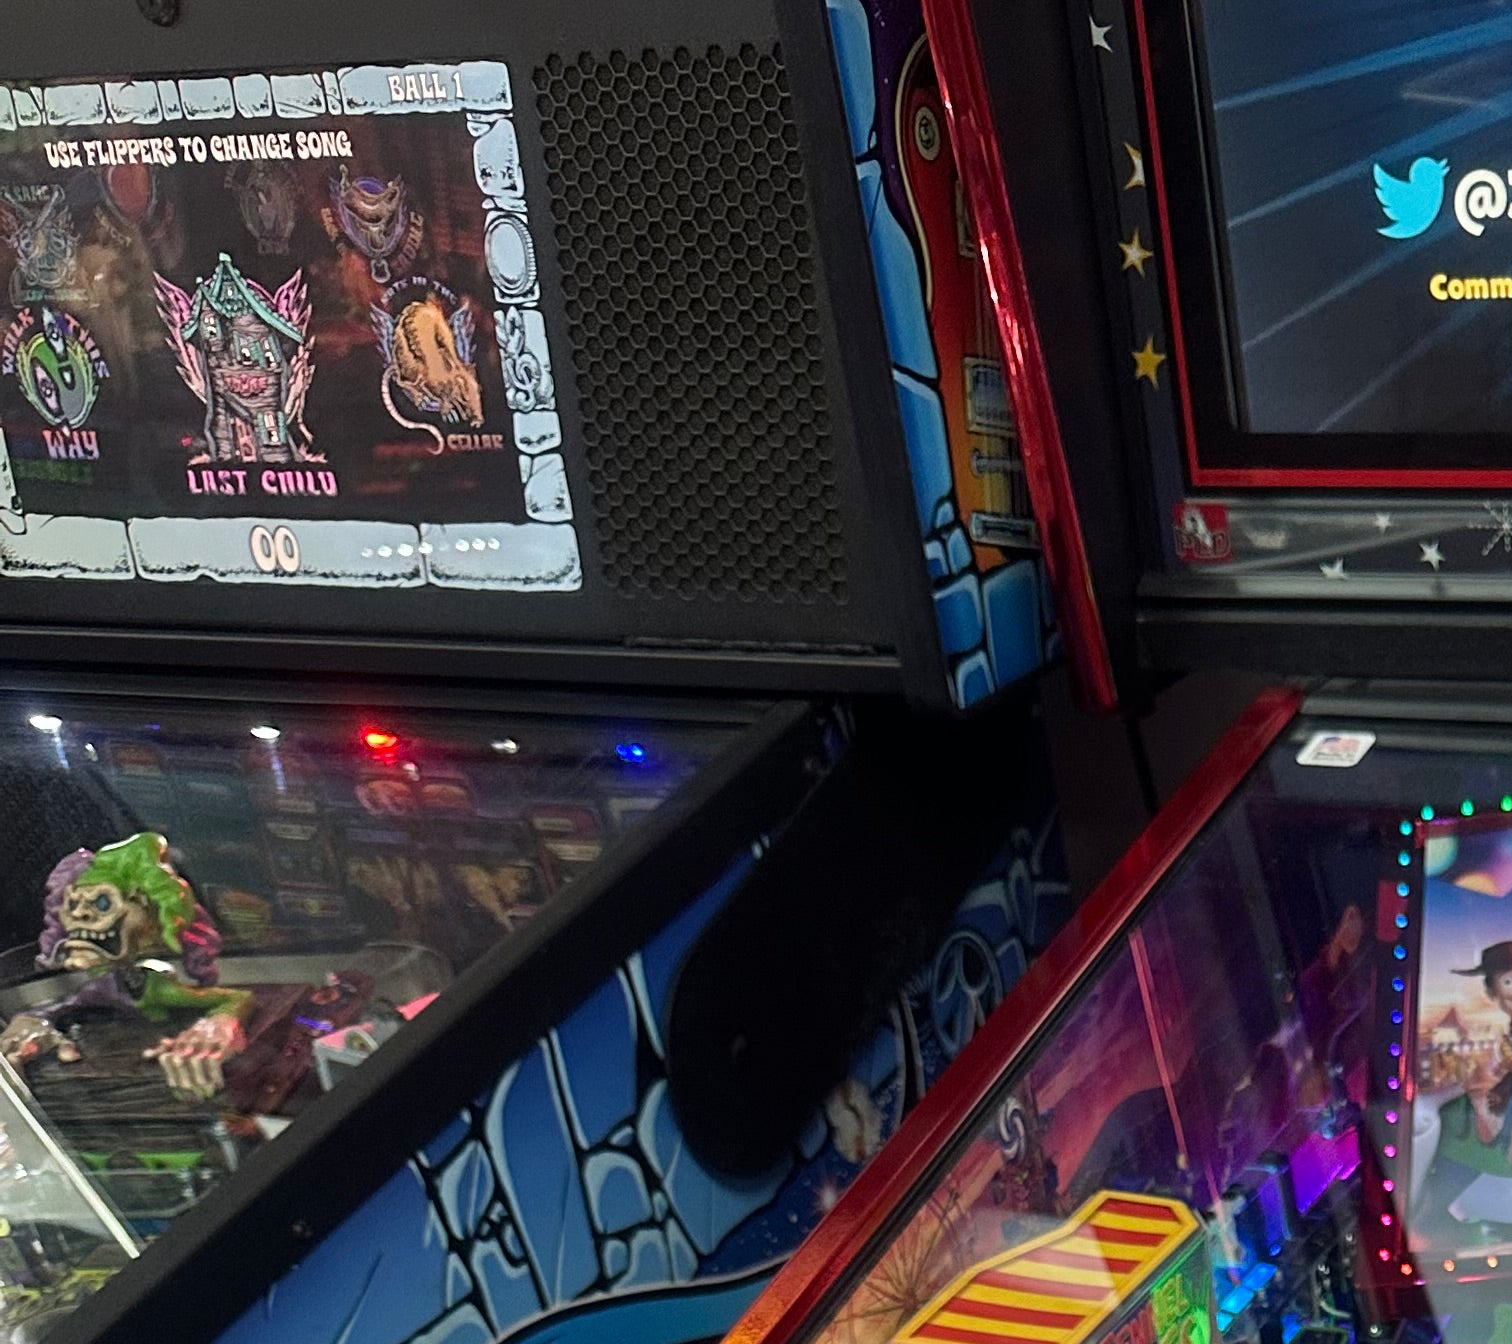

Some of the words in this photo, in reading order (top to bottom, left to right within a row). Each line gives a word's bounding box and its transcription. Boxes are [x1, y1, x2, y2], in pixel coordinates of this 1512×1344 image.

[833, 43, 943, 79] Official
[387, 73, 447, 102] BALL
[451, 73, 463, 98] 1
[44, 141, 82, 169] USE
[85, 136, 177, 168] FLIPPERS
[177, 135, 207, 163] TO
[210, 132, 292, 162] CHANGE
[293, 130, 353, 159] SONG
[43, 430, 99, 460] WAY
[187, 470, 246, 496] LAST
[260, 470, 338, 497] CHILD
[249, 524, 300, 572] 00
